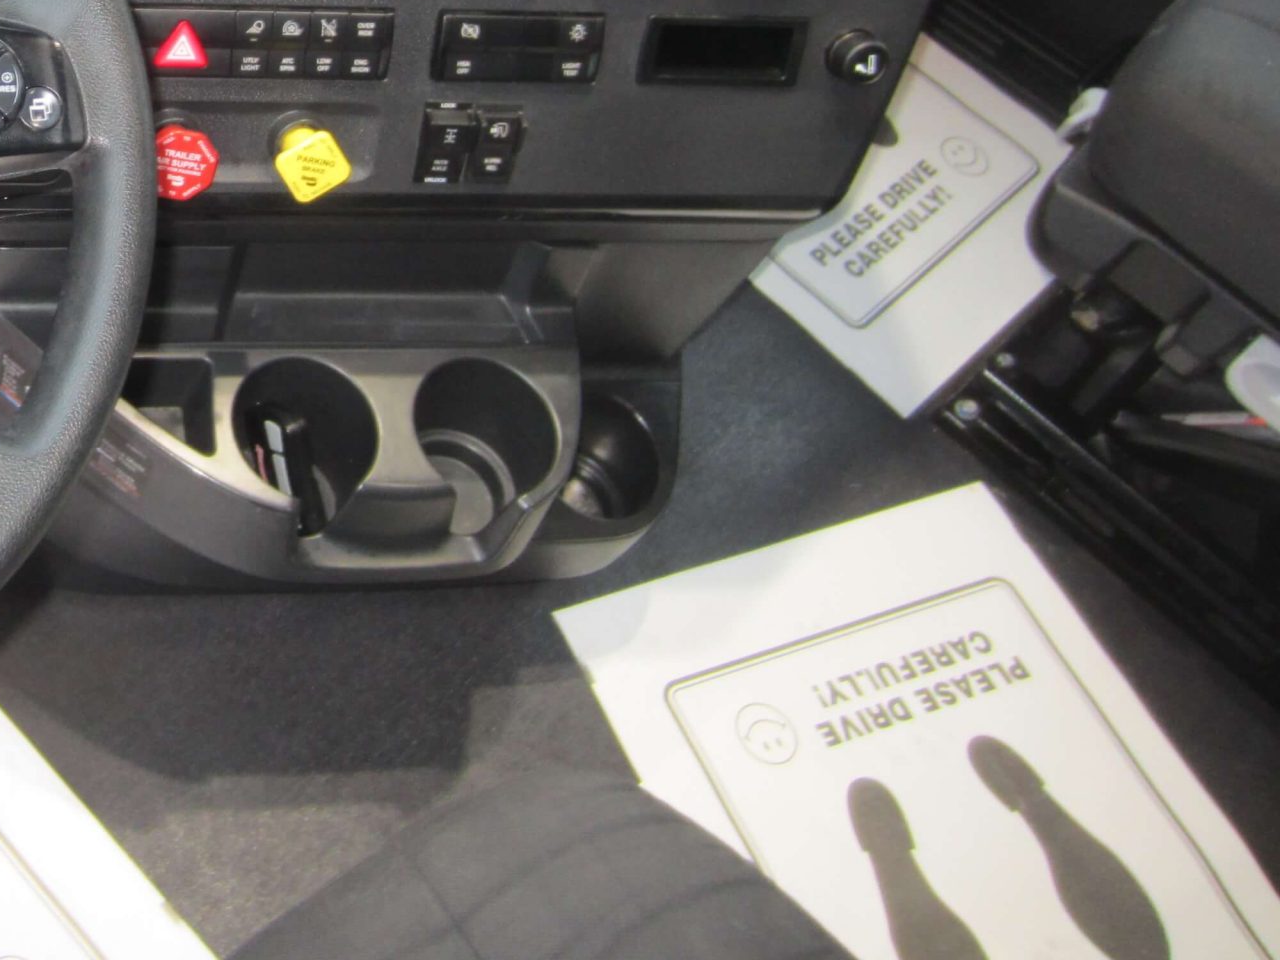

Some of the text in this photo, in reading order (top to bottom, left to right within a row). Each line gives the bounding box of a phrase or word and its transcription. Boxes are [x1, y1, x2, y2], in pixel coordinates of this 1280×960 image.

[0, 85, 16, 93] RES
[165, 149, 202, 162] TRAILER
[171, 159, 207, 171] SUPPLY
[297, 154, 336, 168] PARKING
[809, 159, 938, 267] PLEASE DRIVE
[844, 185, 953, 278] CAREFULLY!
[811, 630, 993, 709] CAREFULLY!
[815, 656, 1031, 747] PLEASE DRIVE
